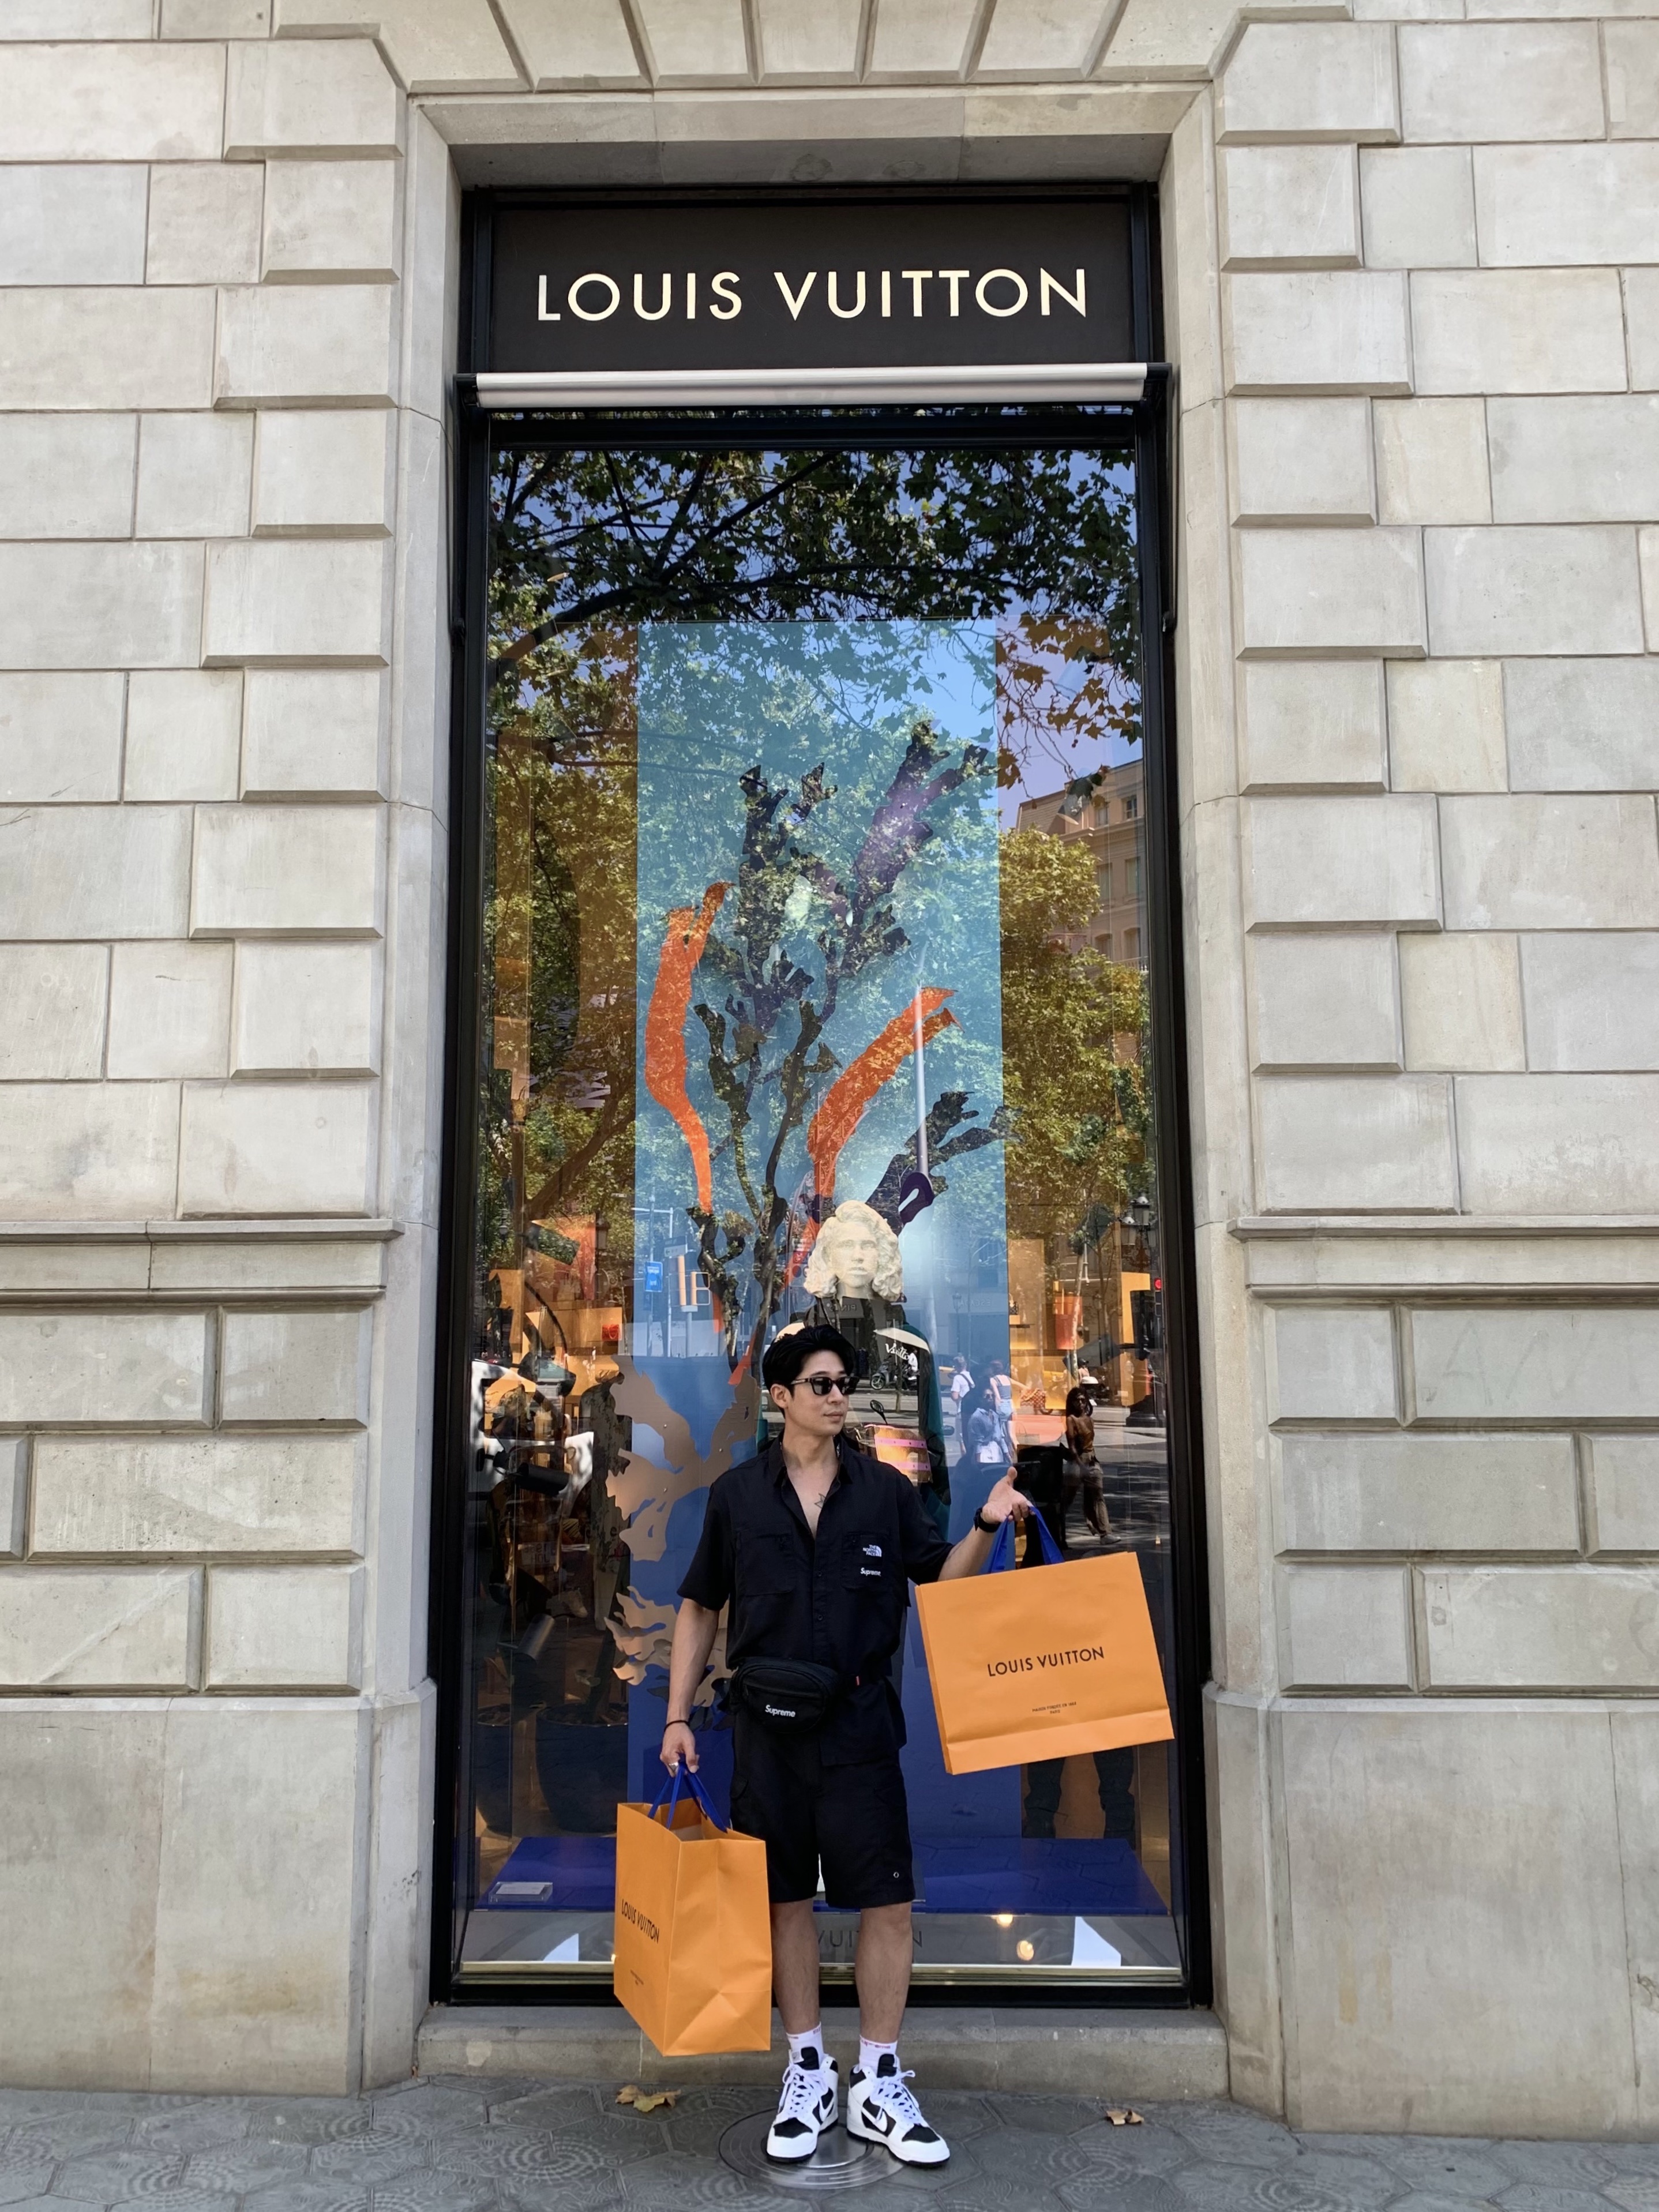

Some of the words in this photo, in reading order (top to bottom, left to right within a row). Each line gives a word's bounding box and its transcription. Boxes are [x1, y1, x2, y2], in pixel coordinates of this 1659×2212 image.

[537, 272, 742, 321] LOUIS
[774, 268, 1087, 320] VUITTON
[860, 1567, 881, 1577] Supreme
[988, 1657, 1033, 1677] LOUIS
[1037, 1646, 1105, 1668] VUITTON
[764, 1704, 796, 1718] Supreme
[621, 1898, 637, 1925] LOUIS
[637, 1911, 660, 1944] VUITTON
